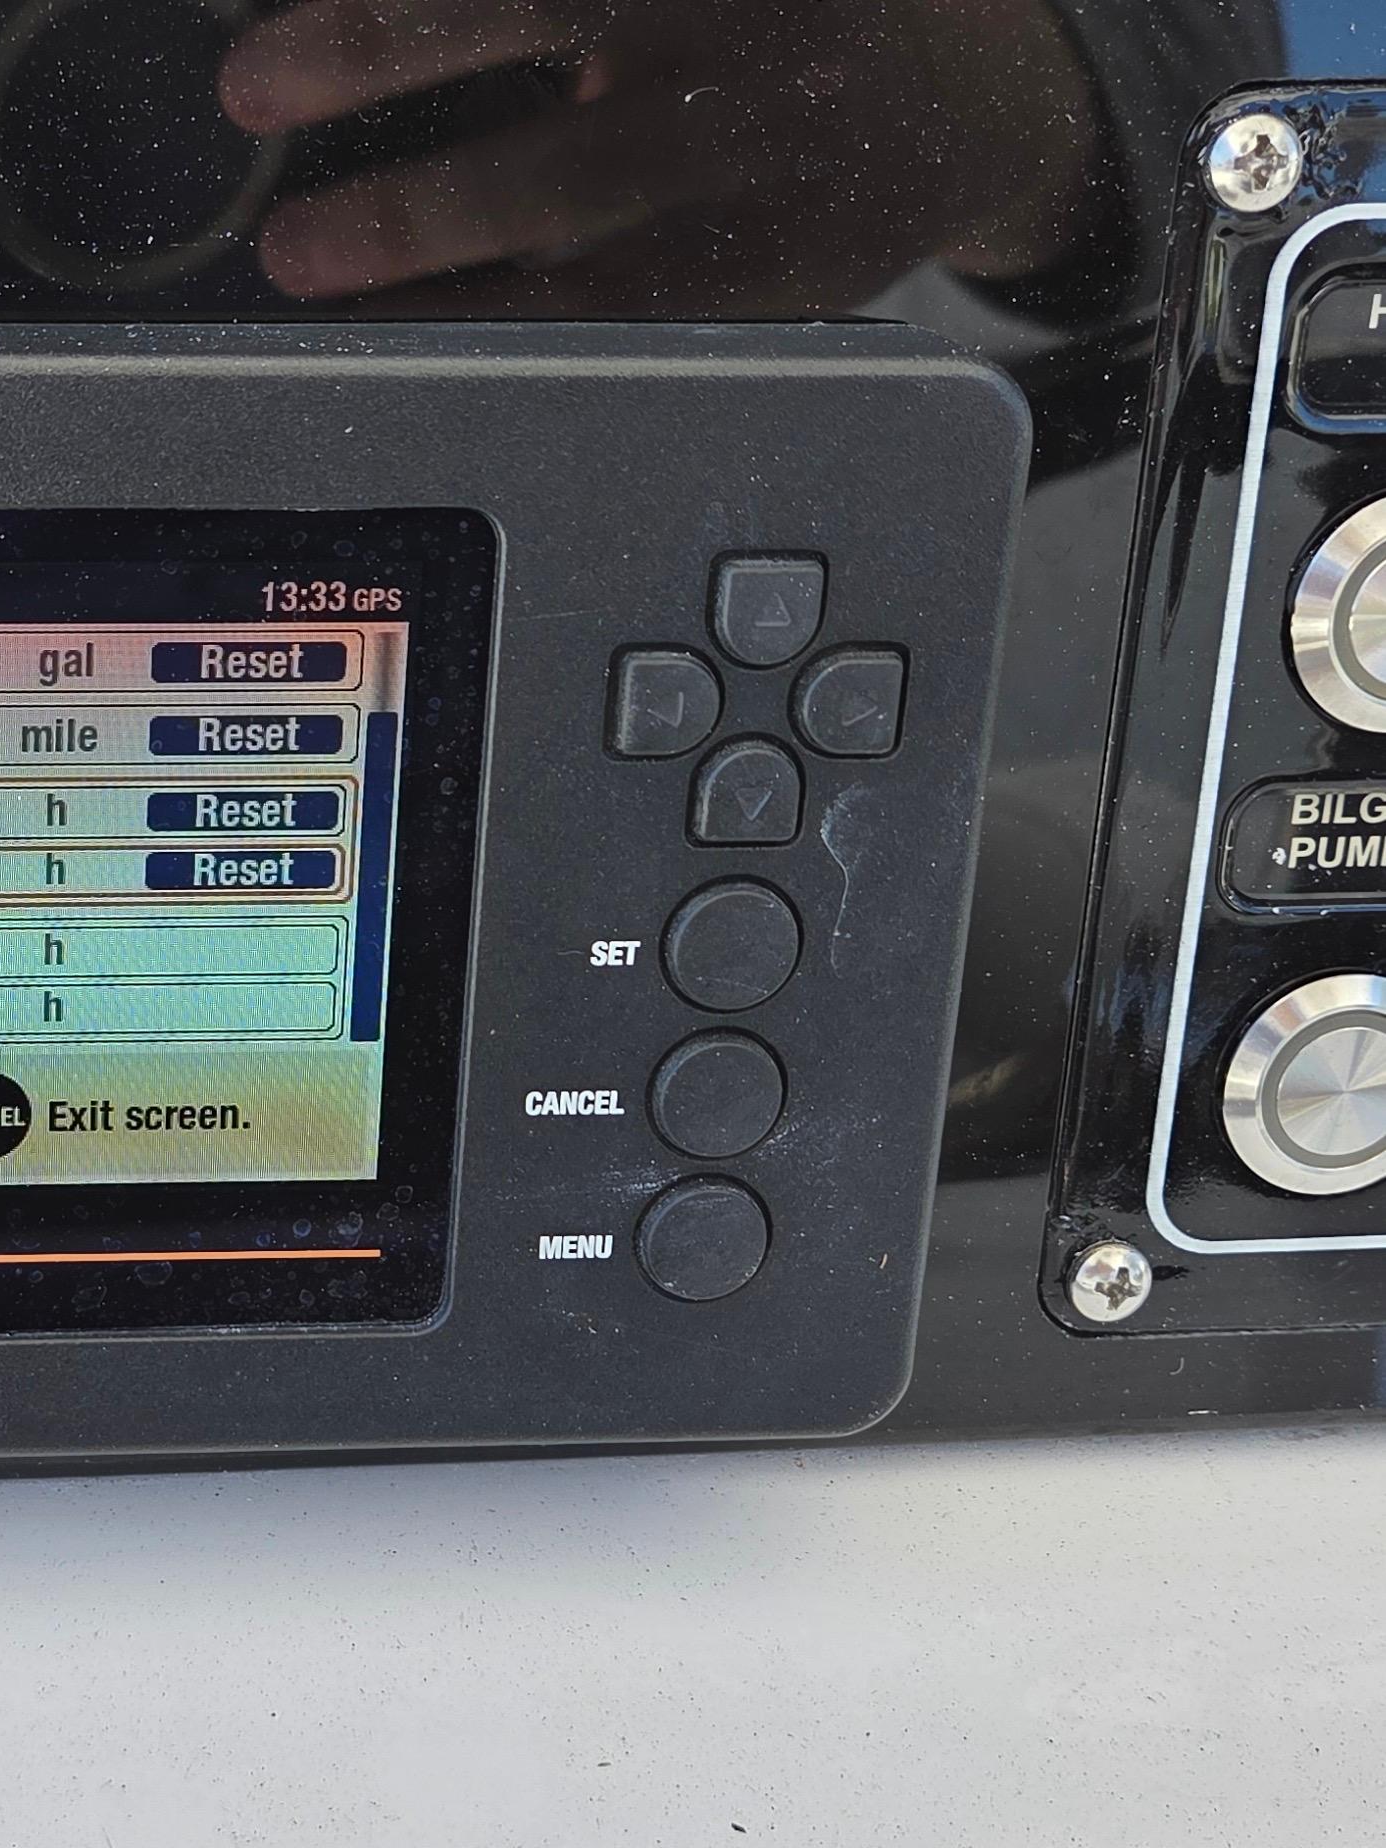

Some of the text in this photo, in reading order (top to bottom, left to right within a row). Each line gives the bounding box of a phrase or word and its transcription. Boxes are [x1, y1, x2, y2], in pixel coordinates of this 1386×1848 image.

[261, 581, 402, 612] 13:33 GPS
[39, 643, 95, 686] gal
[200, 644, 304, 679] Reset
[21, 719, 99, 752] mile
[197, 718, 301, 752] Reset
[46, 794, 67, 827] h
[195, 794, 296, 828] Reset
[1287, 835, 1386, 869] PUM
[44, 853, 65, 885] h
[193, 854, 294, 886] Reset
[43, 934, 63, 966] h
[589, 940, 641, 967] SET
[42, 990, 62, 1022] h
[48, 1100, 251, 1132] Exit screen.
[525, 1090, 625, 1116] CANCEL
[538, 1234, 613, 1260] MENU
